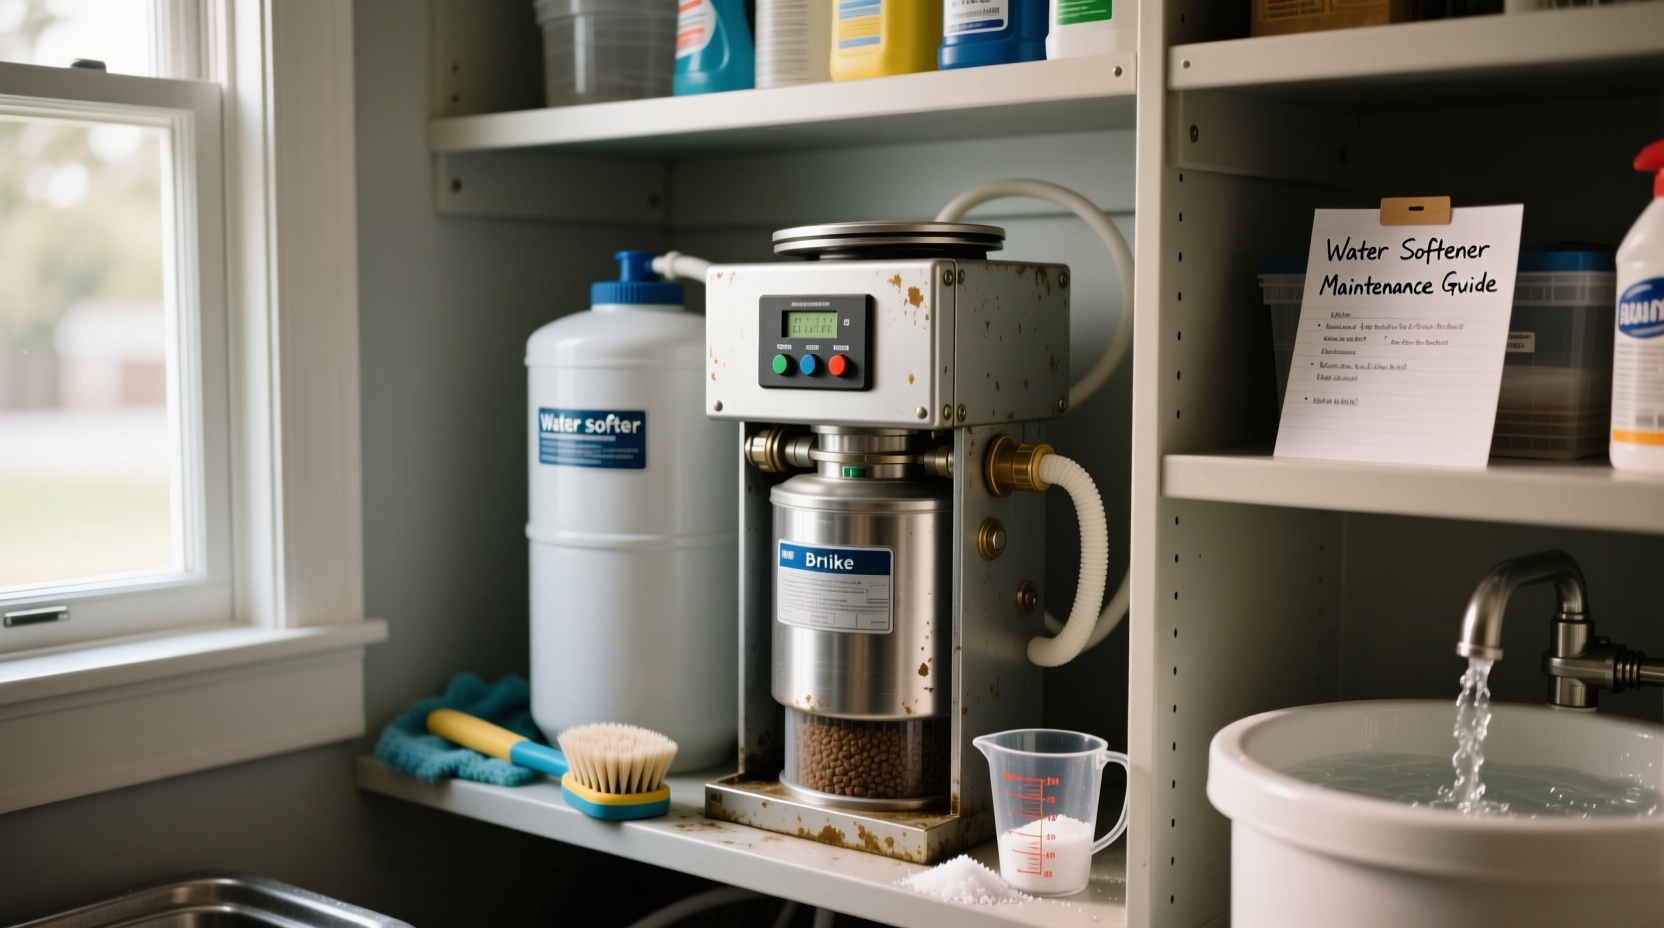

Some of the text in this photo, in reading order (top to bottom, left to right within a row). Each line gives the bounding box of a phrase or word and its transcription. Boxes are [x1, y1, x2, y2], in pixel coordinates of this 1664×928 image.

[1327, 236, 1490, 265] Water Softener
[1319, 271, 1498, 297] Maintenance Guide
[585, 413, 641, 434] softer
